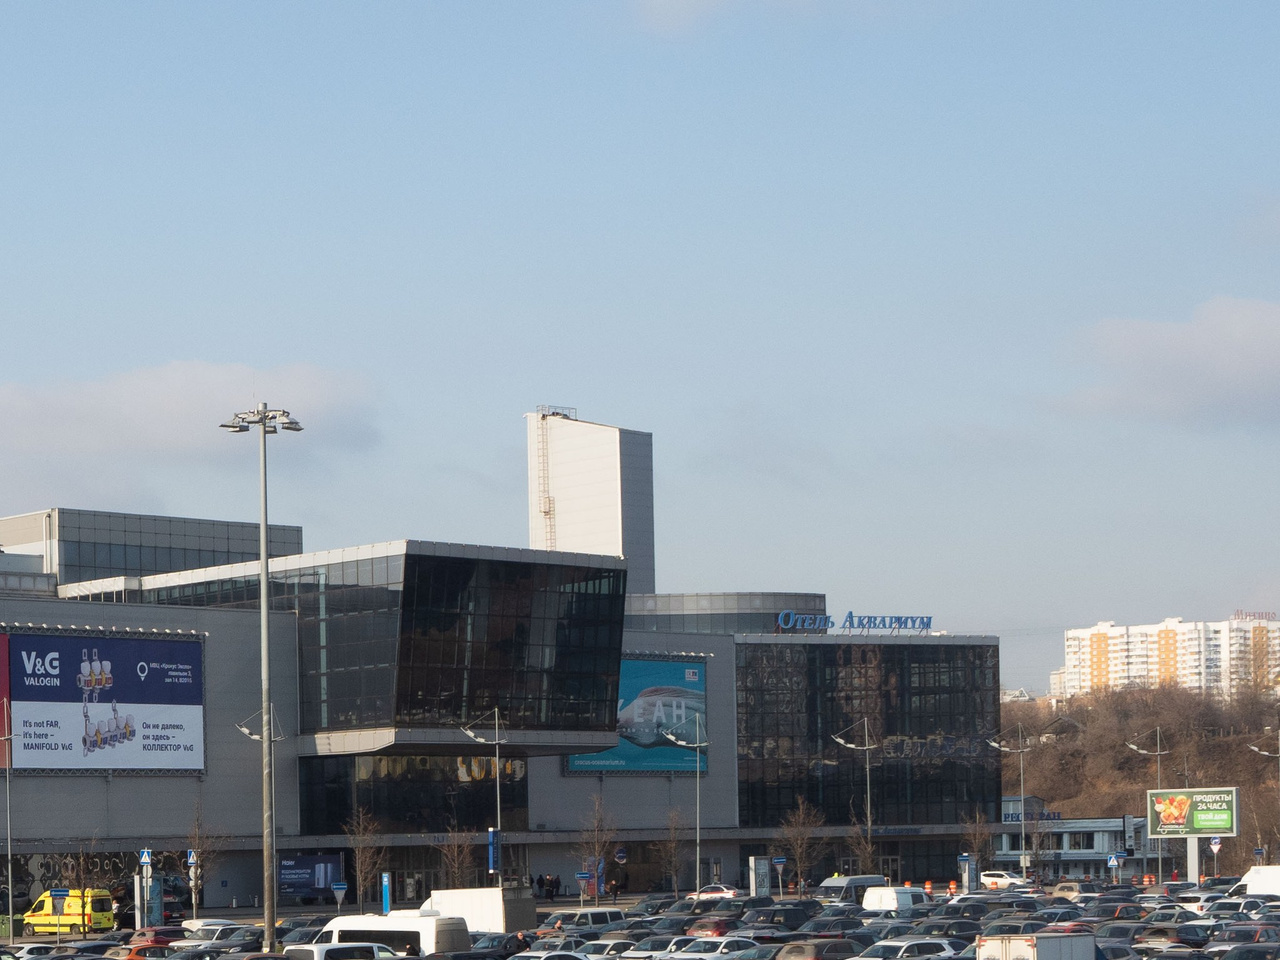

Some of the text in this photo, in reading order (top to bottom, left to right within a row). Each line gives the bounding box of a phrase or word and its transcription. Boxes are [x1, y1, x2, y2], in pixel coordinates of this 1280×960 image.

[21, 651, 60, 675] V&G
[24, 677, 60, 687] VALOGIN
[33, 721, 45, 729] not
[142, 722, 152, 730] Он
[33, 732, 48, 740] here
[142, 733, 151, 741] он
[23, 742, 59, 751] MANIFOLD
[142, 743, 182, 752] КОЛЛЕКТОР
[1193, 794, 1232, 802] ПРОДУКТЫ
